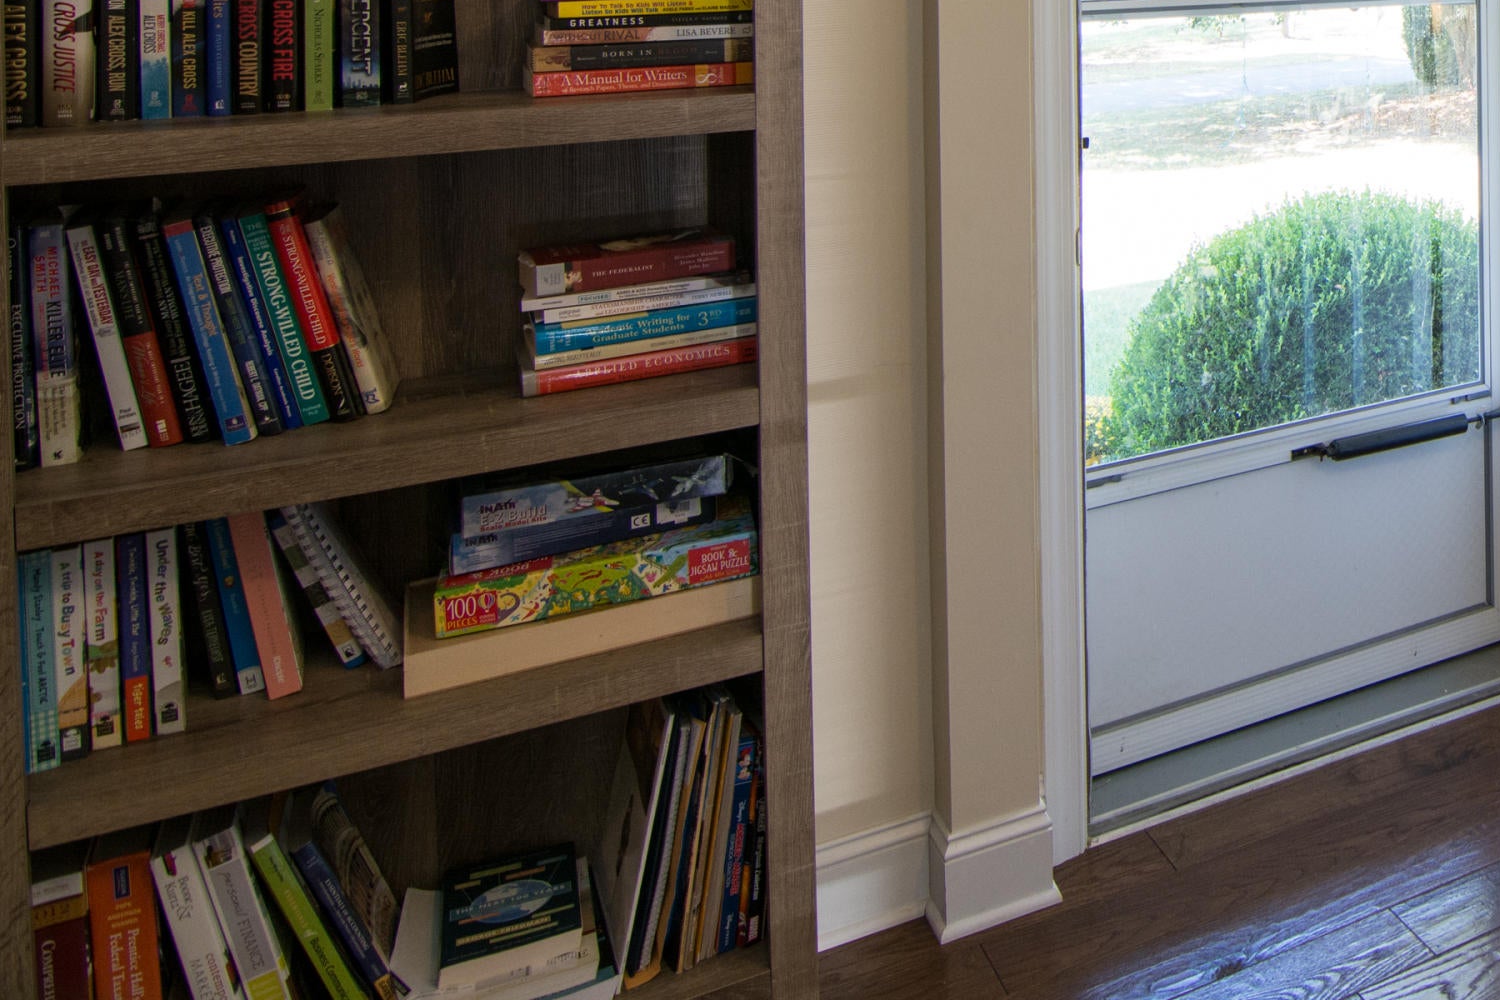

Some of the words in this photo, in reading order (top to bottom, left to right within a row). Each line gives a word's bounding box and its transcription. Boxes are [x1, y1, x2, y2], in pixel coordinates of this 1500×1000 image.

[4, 5, 27, 43] ALEX
[53, 2, 76, 43] CROSS
[107, 15, 126, 39] ALEX
[143, 14, 156, 31] ALEX
[182, 10, 197, 31] KILL
[271, 0, 294, 45] CROSS
[396, 20, 408, 41] ERIC
[569, 16, 645, 28] GREATNESS
[676, 29, 697, 38] LISA
[700, 26, 737, 37] BEVERE
[143, 31, 156, 55] CROSS
[182, 32, 197, 57] ALEX
[603, 29, 641, 42] RIVAL
[271, 48, 294, 81] FIRE
[396, 43, 408, 77] BLEHM
[602, 49, 634, 58] BORN
[640, 48, 654, 57] IN
[5, 47, 28, 102] CROSS
[53, 43, 76, 95] JUSTICE
[182, 57, 197, 90] CROSS
[237, 41, 259, 96] COUNTRY
[314, 51, 324, 83] SPARKS
[561, 73, 572, 87] A
[574, 71, 623, 86] Manual
[626, 69, 643, 83] for
[643, 67, 689, 82] Writers
[107, 71, 126, 93] RUN
[199, 224, 221, 259] EXECUTIVE
[82, 246, 97, 265] EASY
[35, 255, 48, 294] SMITH
[48, 246, 61, 299] MICHAEL
[86, 264, 101, 280] DAY
[208, 257, 232, 295] PROTECTION
[591, 270, 607, 279] THE
[608, 263, 656, 276] FEDERALIST
[281, 234, 317, 314] STRONG-WILLED
[306, 313, 327, 346] CHILD
[92, 283, 113, 326] YESTERDAY
[192, 272, 205, 292] Text
[199, 301, 219, 337] Thought
[46, 300, 64, 343] KILLER
[255, 250, 303, 358] STRONG-WILLED
[290, 358, 317, 401] CHILD
[637, 316, 675, 329] Writing
[676, 313, 691, 323] for
[696, 311, 710, 327] 3
[12, 304, 23, 364] EXECUTIVE
[592, 330, 640, 344] Graduate
[640, 323, 685, 336] Students
[48, 345, 67, 380] ELITE
[644, 346, 731, 368] ECONOMICS
[12, 364, 26, 431] PROTECTION
[173, 360, 202, 413] HAGEE
[508, 503, 548, 522] Build
[480, 524, 503, 532] Scale
[60, 562, 70, 570] A
[93, 558, 105, 577] day
[154, 539, 171, 578] Under
[689, 562, 718, 577] JIGSAW
[719, 555, 751, 570] PUZZLE
[700, 550, 725, 565] BOOK
[59, 571, 71, 590] trip
[95, 577, 102, 590] on
[153, 581, 169, 602] the
[61, 591, 71, 603] to
[96, 590, 105, 606] the
[446, 595, 478, 621] 100
[57, 605, 75, 637] Busy
[94, 606, 108, 641] Farm
[156, 602, 174, 646] Waves
[447, 616, 479, 630] PIECES
[35, 627, 45, 649] Touch
[60, 637, 76, 674] Town
[39, 675, 48, 704] ARCTIC
[131, 681, 146, 705] tiger
[132, 705, 144, 729] tales
[109, 932, 126, 972] Federal
[127, 928, 142, 972] Prentice
[237, 919, 266, 971] FINANCE
